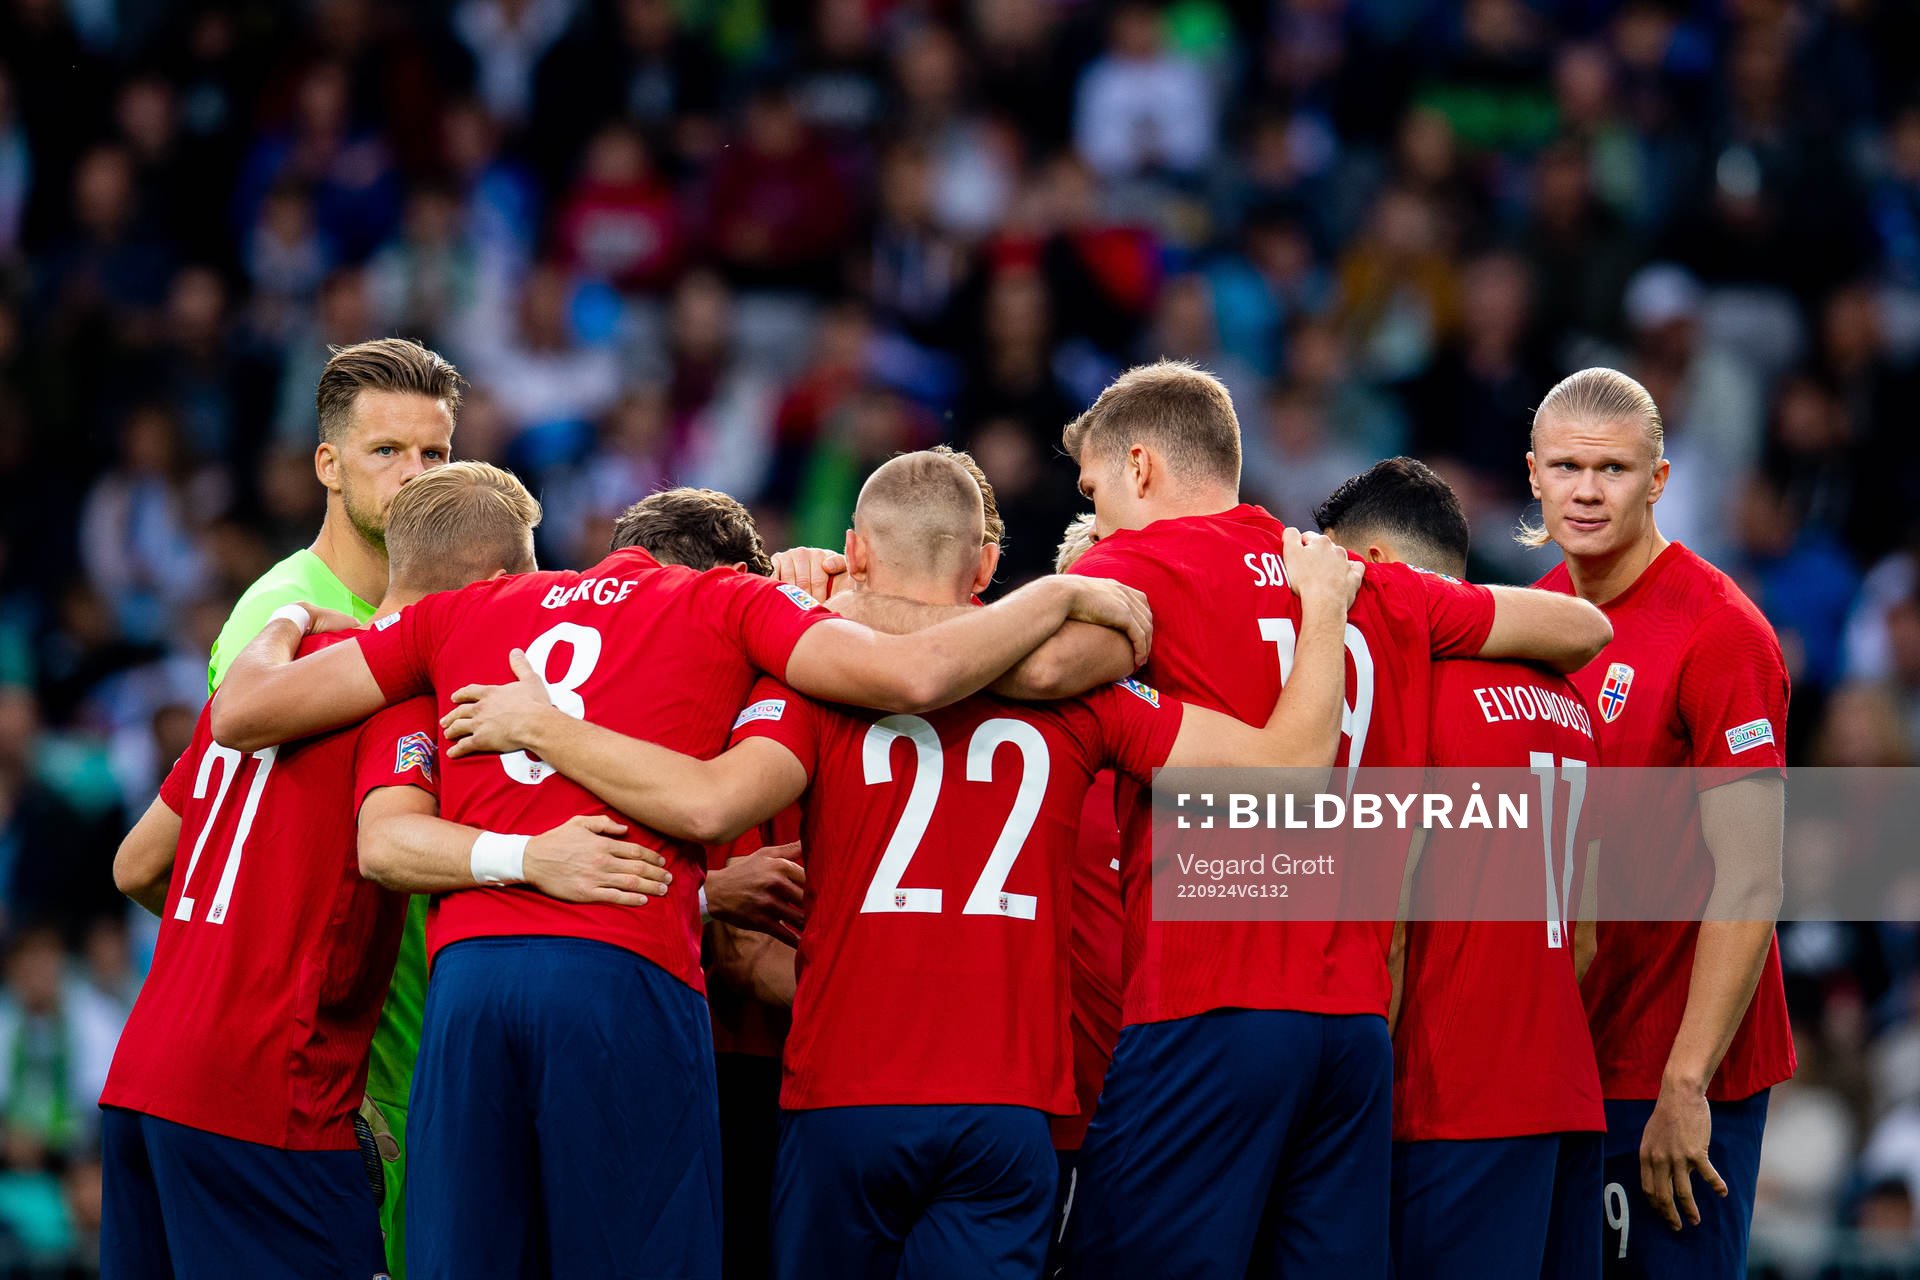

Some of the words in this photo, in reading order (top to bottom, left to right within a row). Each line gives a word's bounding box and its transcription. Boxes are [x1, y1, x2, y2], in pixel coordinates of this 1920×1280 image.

[1243, 552, 1292, 588] SØ
[499, 621, 602, 785] 8
[1472, 685, 1594, 741] ELYOUNOUSS
[173, 740, 280, 925] 21
[859, 713, 1050, 920] 22
[1529, 750, 1588, 949] 11
[1603, 1182, 1630, 1259] 9
